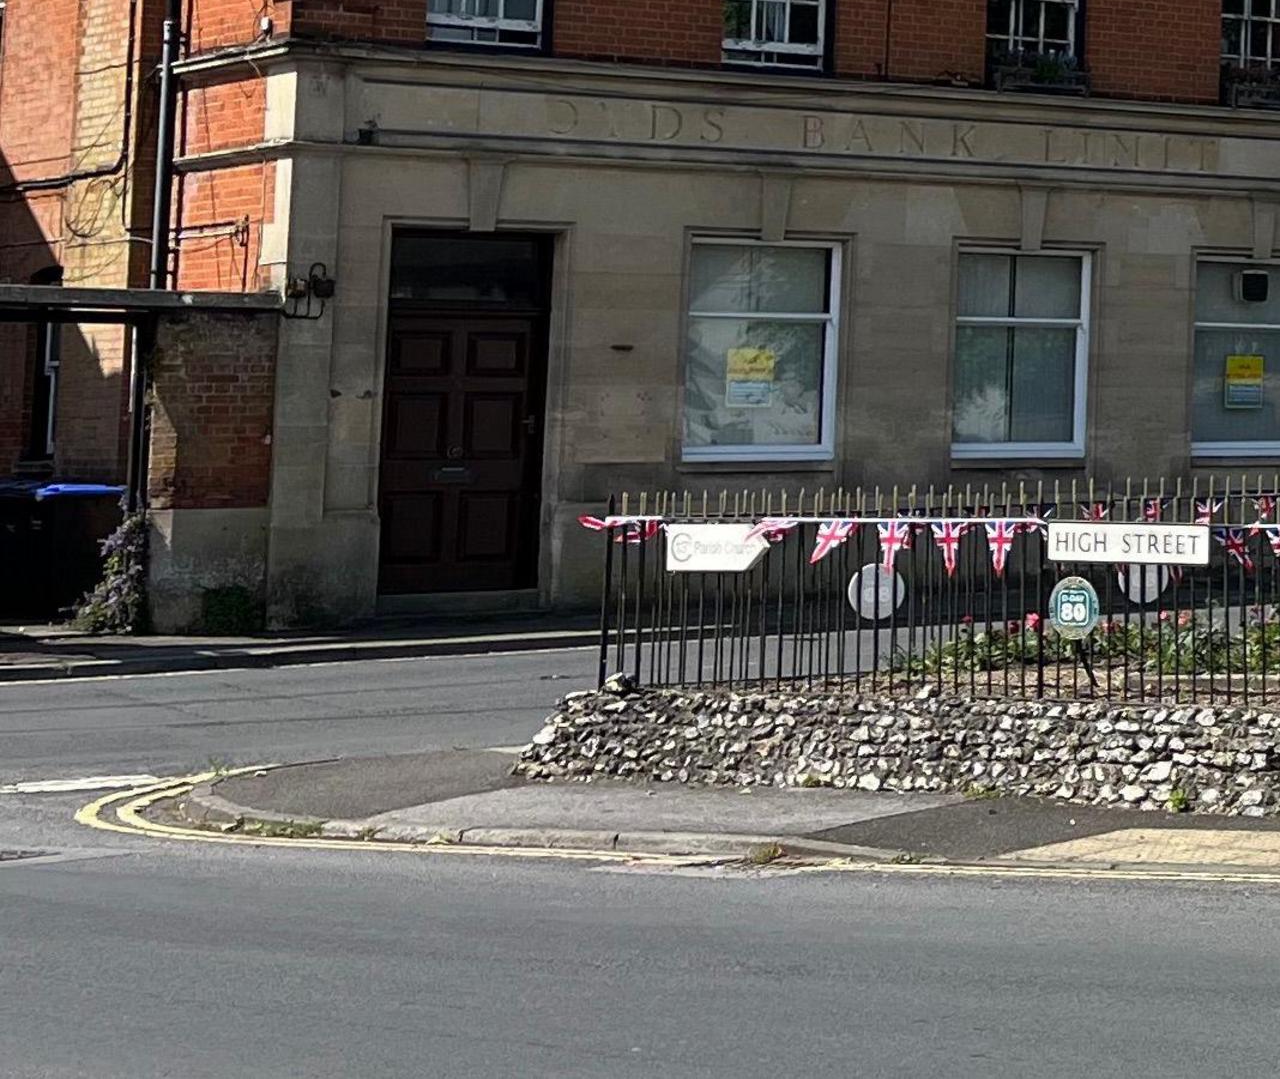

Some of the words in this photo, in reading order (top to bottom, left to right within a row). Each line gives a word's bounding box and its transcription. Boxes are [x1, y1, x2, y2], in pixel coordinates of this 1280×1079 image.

[802, 115, 977, 158] BANK
[1055, 532, 1107, 553] HIGH
[1122, 533, 1201, 555] STREET
[1060, 602, 1086, 622] 80
